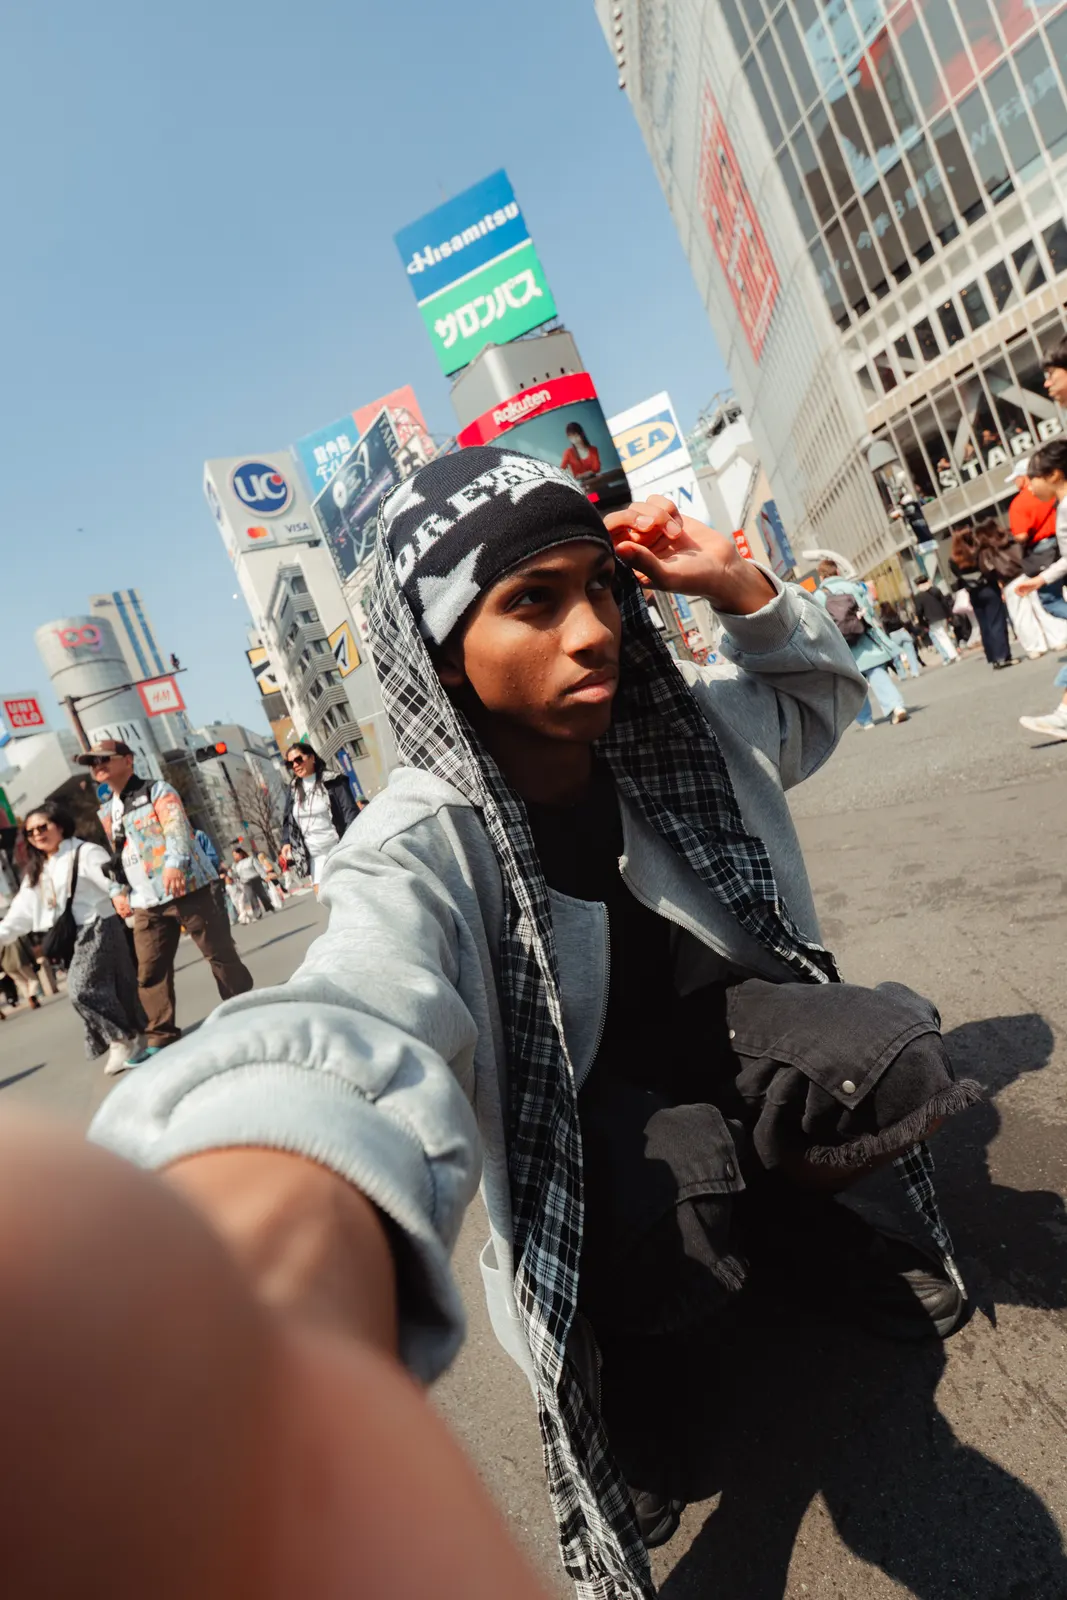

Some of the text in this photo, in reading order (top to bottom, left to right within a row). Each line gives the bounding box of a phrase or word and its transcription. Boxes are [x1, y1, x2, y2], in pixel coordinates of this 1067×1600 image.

[406, 201, 520, 275] Hisamitsu
[433, 268, 544, 350] サロンパス
[492, 389, 552, 426] Rakuten
[284, 521, 310, 534] VISA
[6, 701, 35, 714] UNI
